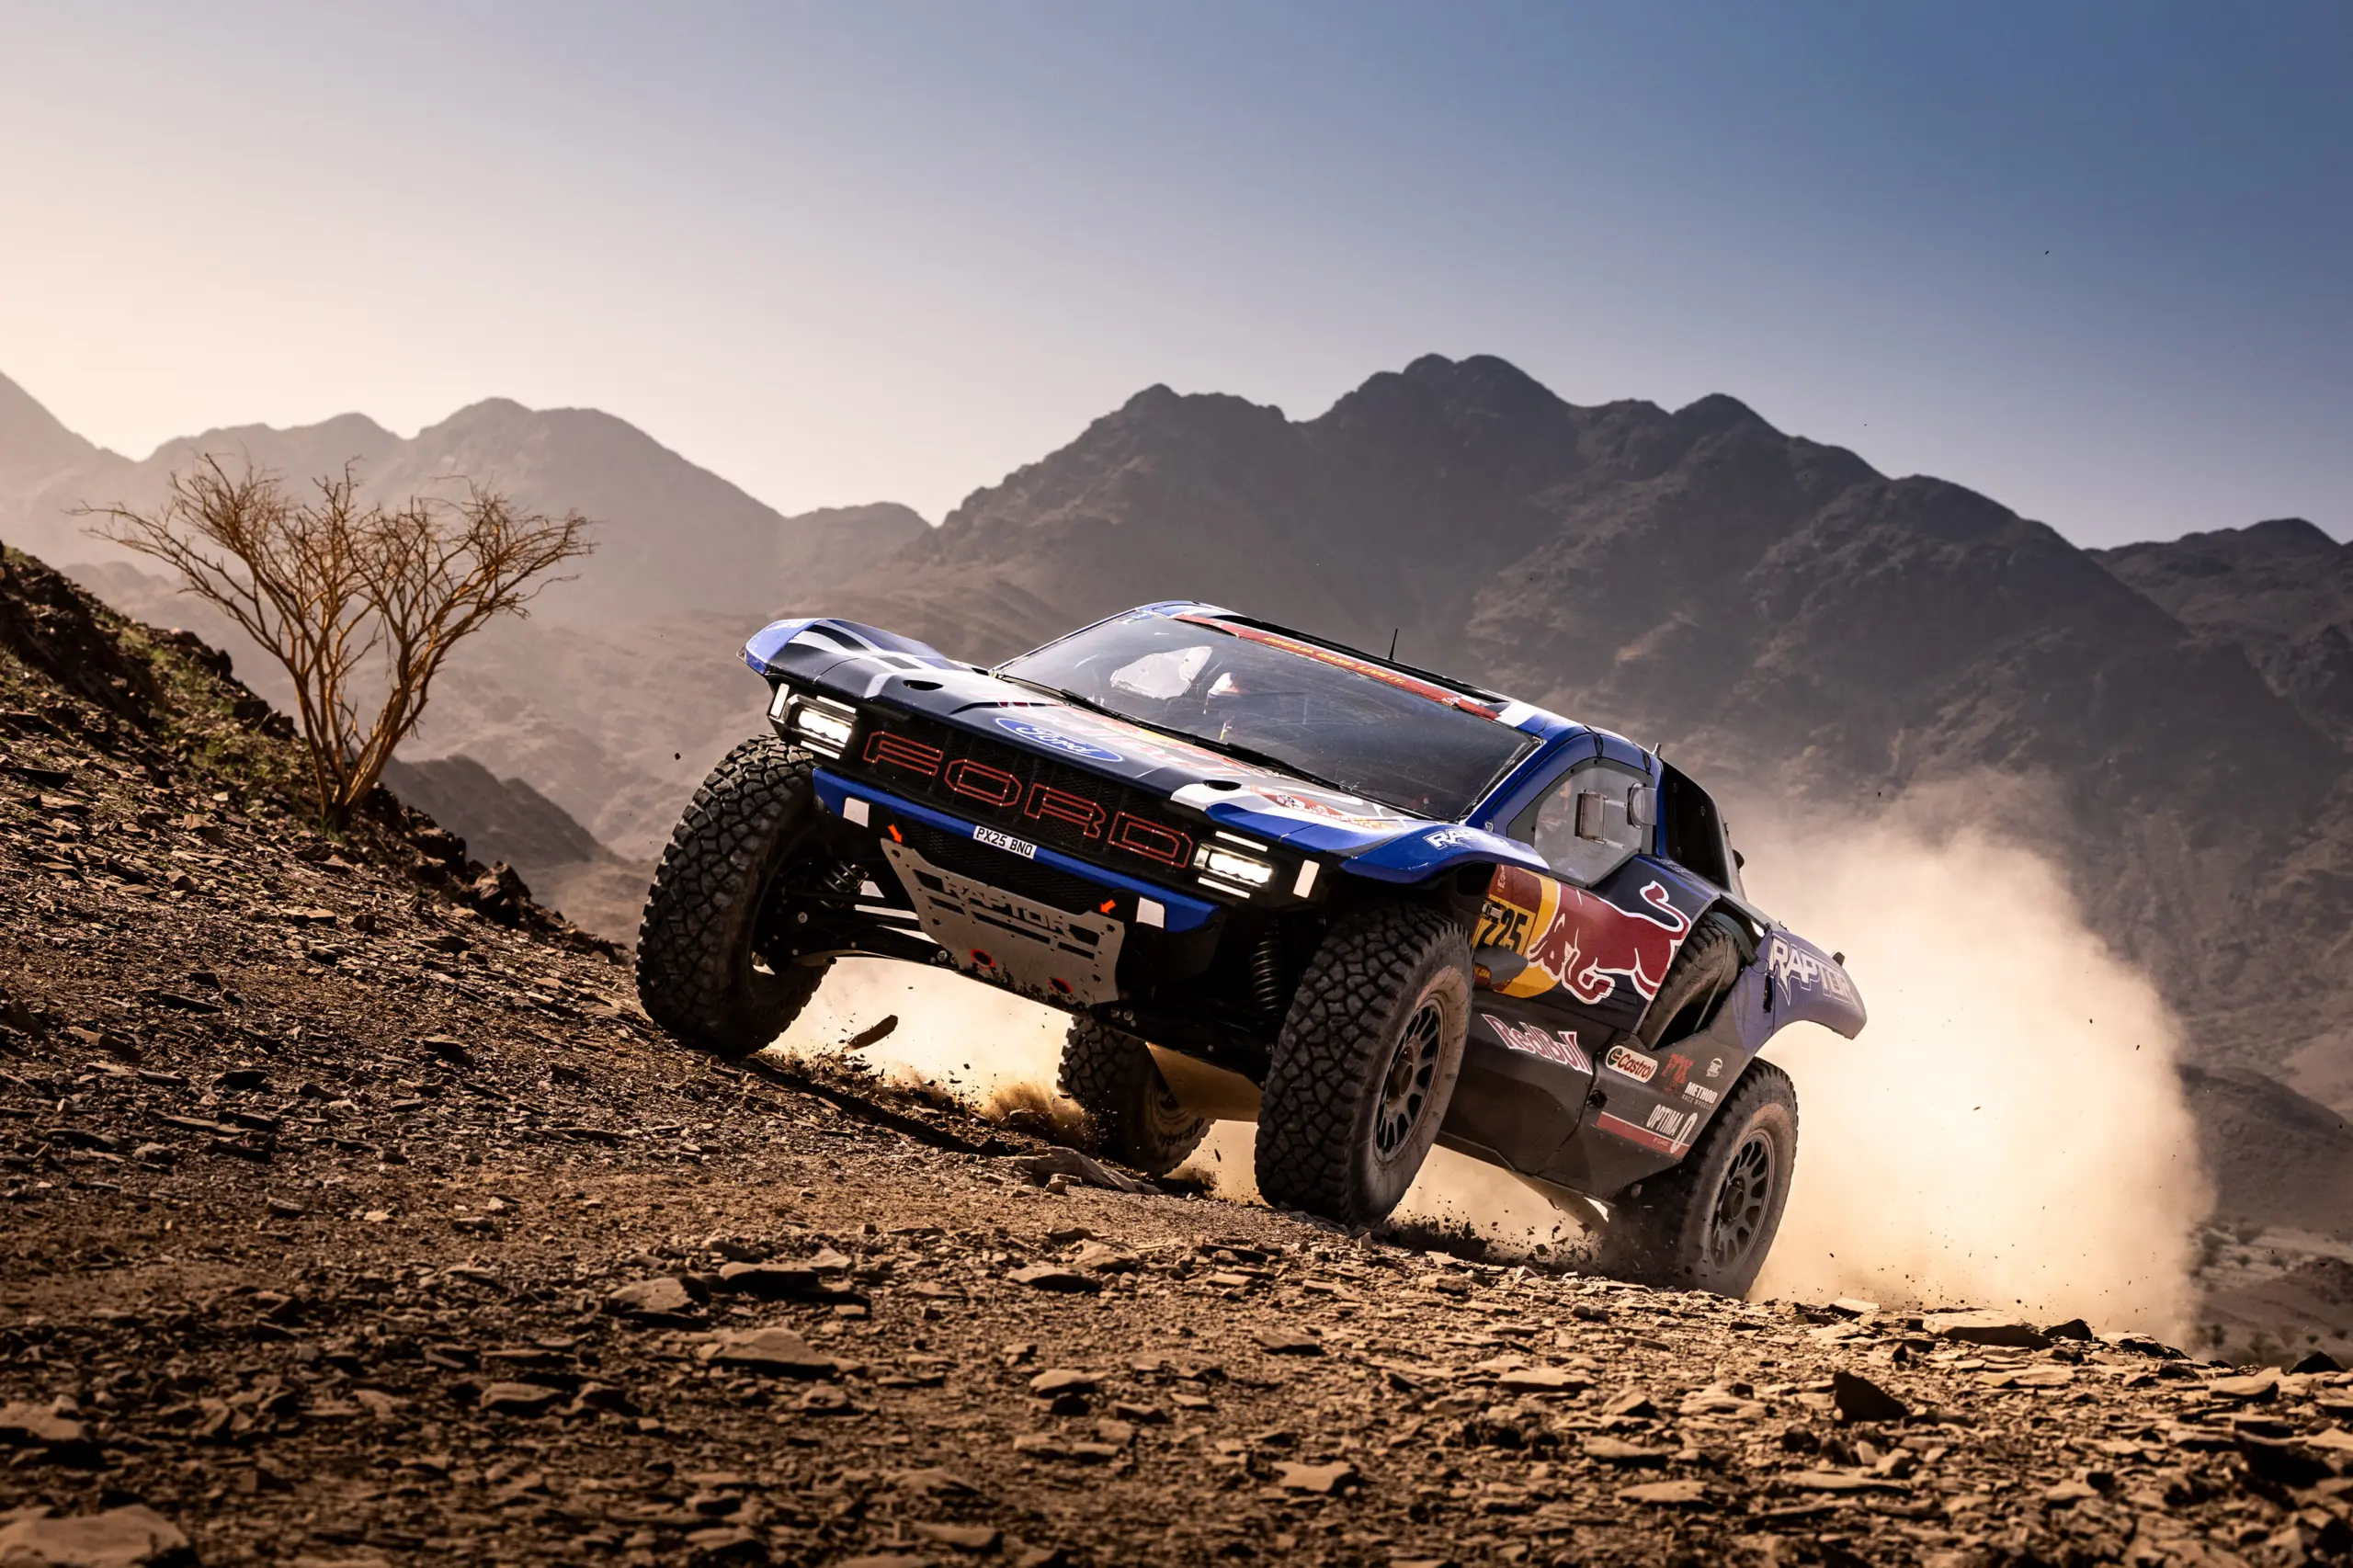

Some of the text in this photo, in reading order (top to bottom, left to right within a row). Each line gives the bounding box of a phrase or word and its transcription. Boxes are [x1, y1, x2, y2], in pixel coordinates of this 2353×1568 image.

[1015, 724, 1102, 756] Ford
[862, 731, 1194, 869] FORD
[975, 826, 1033, 857] PX25 BNO
[944, 882, 1073, 941] RAPTOR
[1768, 933, 1853, 1006] RAPTOR
[1618, 1053, 1655, 1079] Castrol
[1684, 1081, 1718, 1104] METHOD
[1646, 1104, 1684, 1137] OPTIMA
